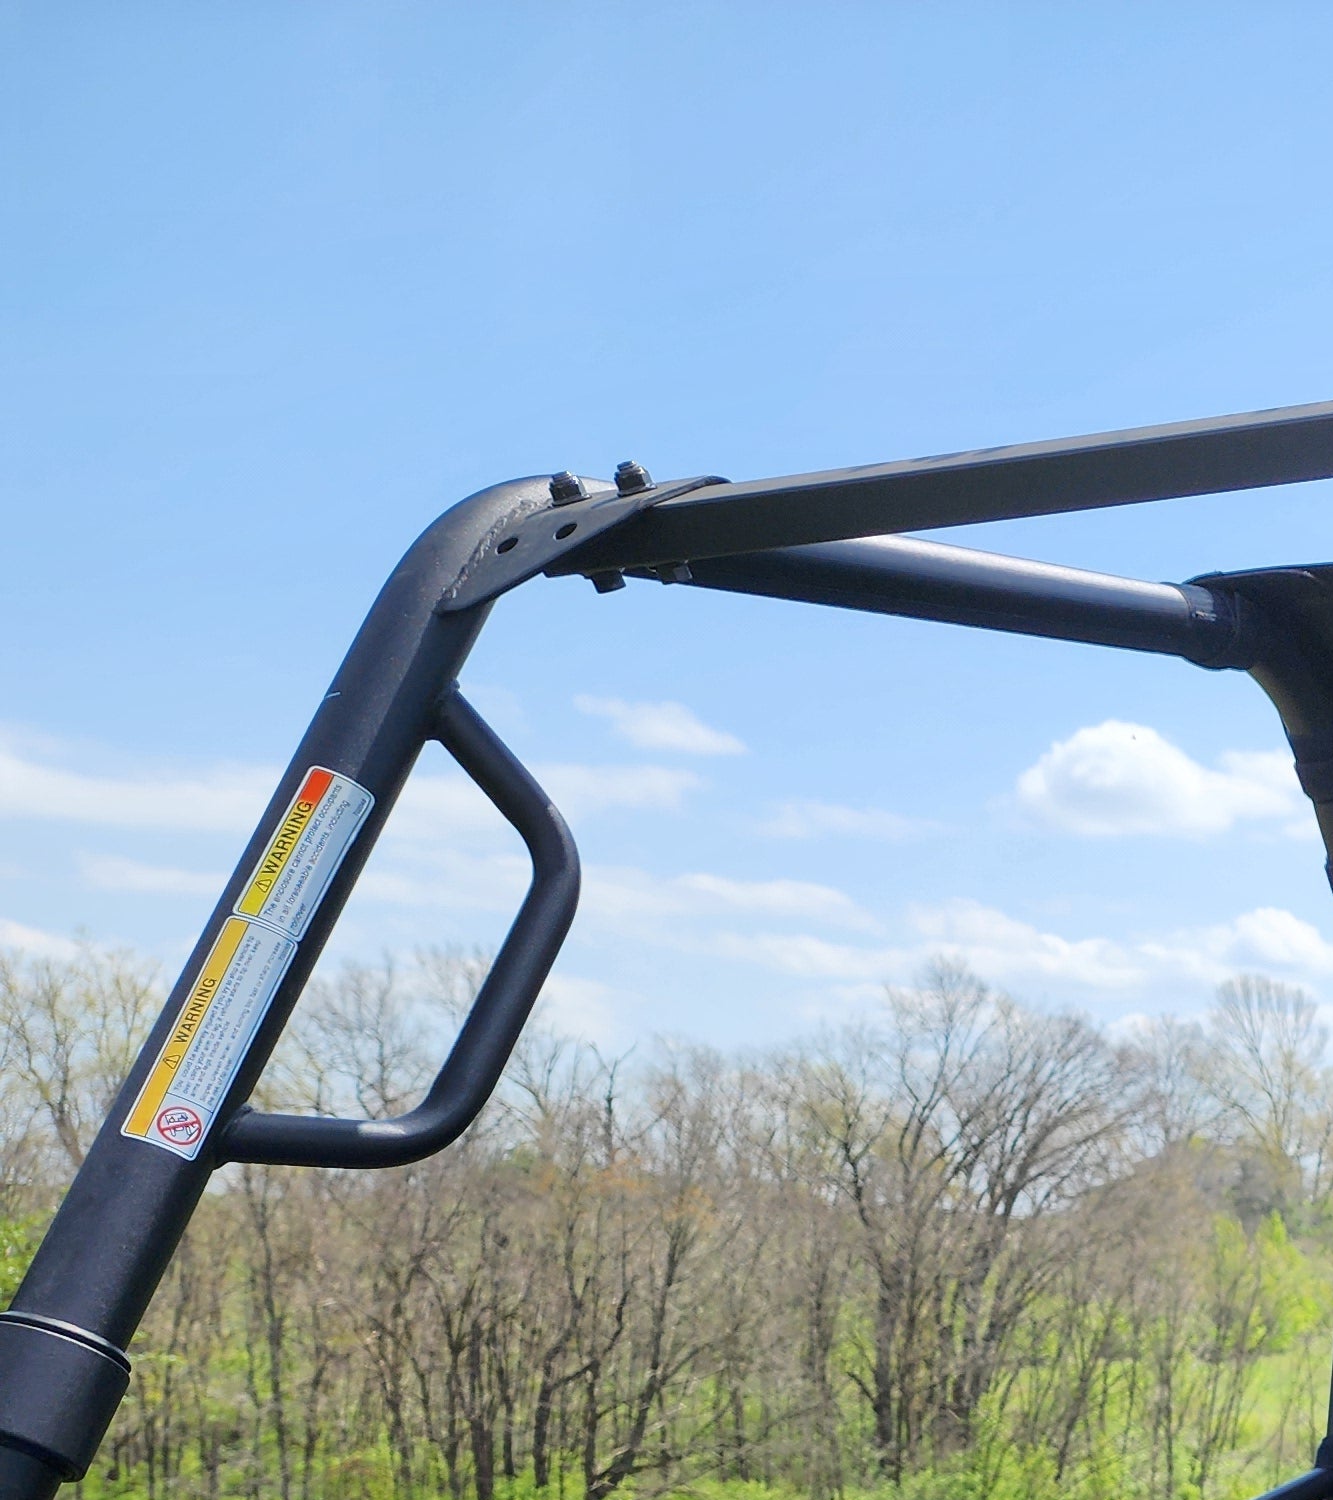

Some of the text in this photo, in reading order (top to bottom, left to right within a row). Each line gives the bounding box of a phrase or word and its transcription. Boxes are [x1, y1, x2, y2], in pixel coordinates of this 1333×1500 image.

[259, 797, 313, 878] WARNING
[263, 782, 343, 917] The enclosure cannot protect occupants
[172, 975, 218, 1046] WARNING
